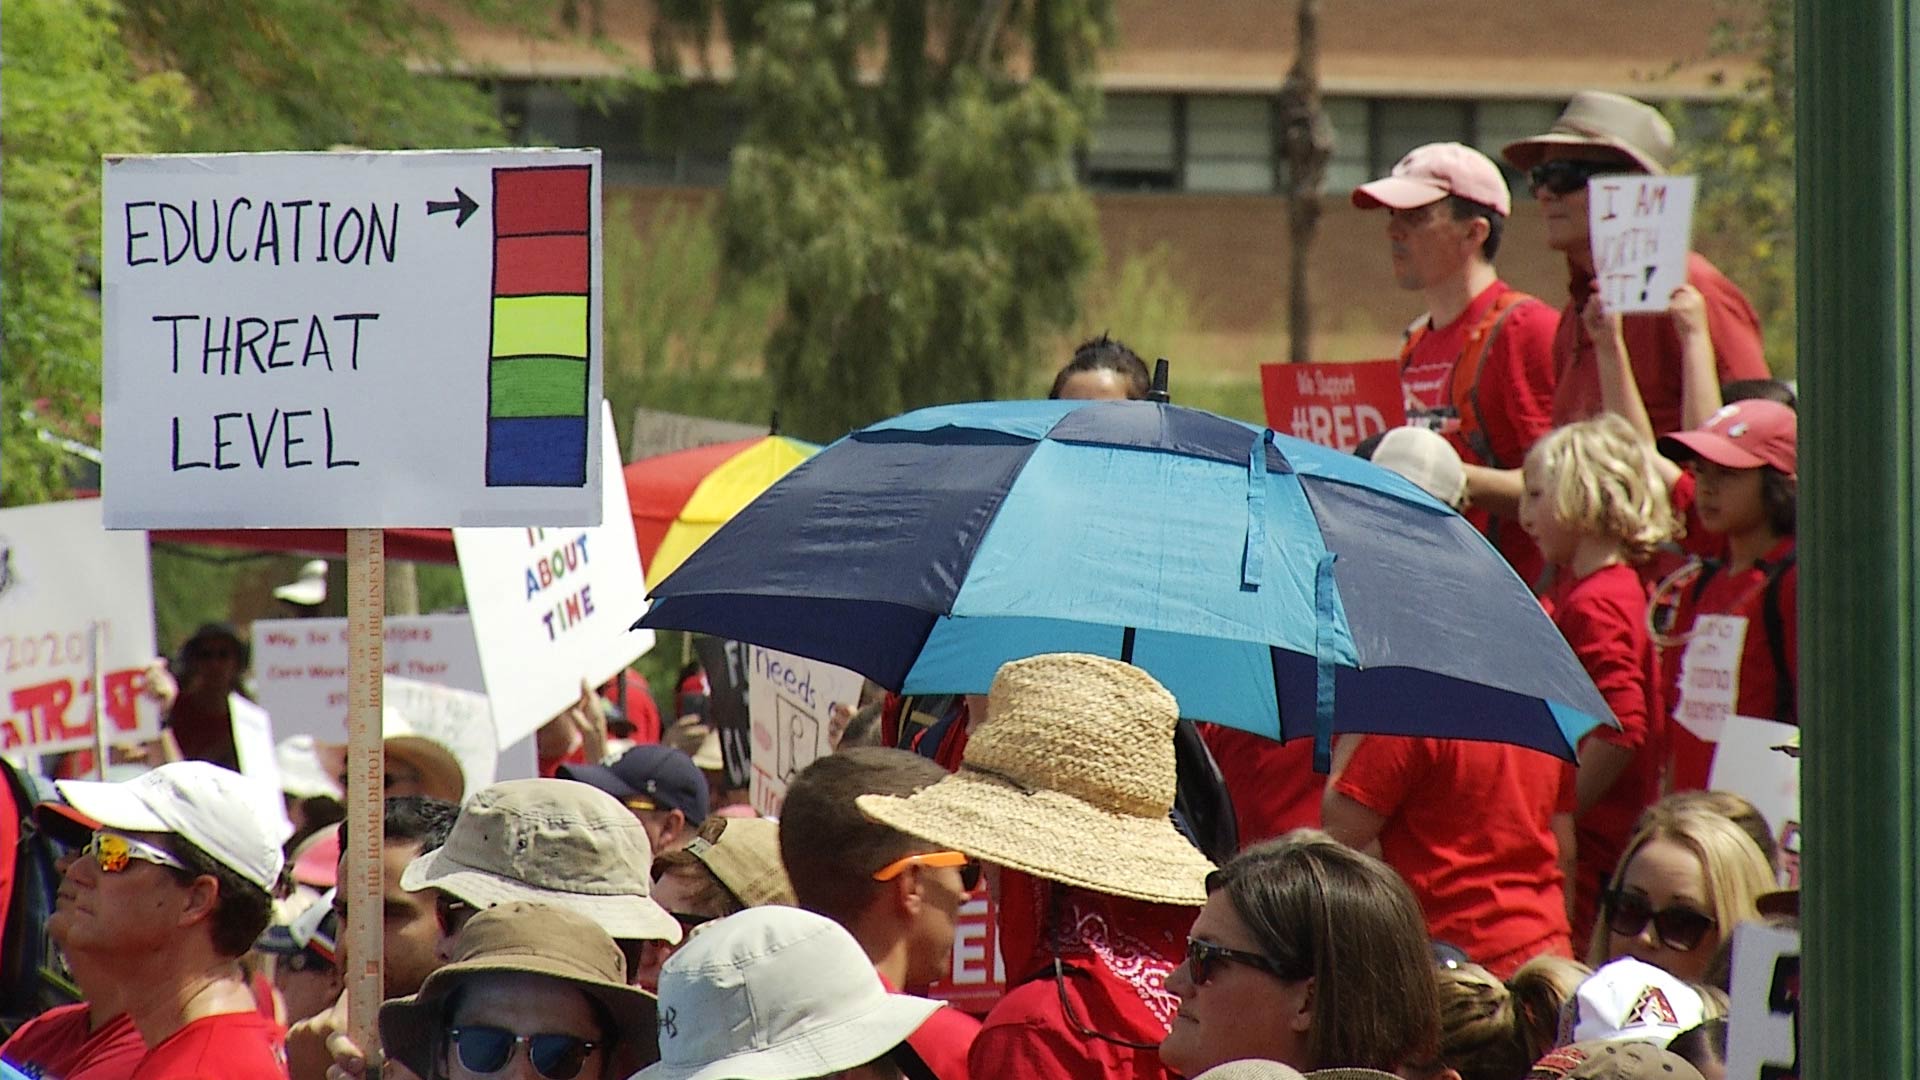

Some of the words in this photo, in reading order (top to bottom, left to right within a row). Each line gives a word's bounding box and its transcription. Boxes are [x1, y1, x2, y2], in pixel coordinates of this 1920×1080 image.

[1603, 185, 1620, 220] I
[1634, 183, 1667, 217] AM
[125, 197, 400, 266] EDUCATION
[152, 314, 380, 375] THREAT
[1296, 372, 1314, 396] We
[1317, 369, 1356, 403] Support
[171, 407, 360, 472] LEVEL
[526, 533, 588, 601] ABOUT
[542, 583, 595, 641] TIME
[755, 648, 817, 711] needs
[368, 749, 380, 803] DEPOT
[368, 813, 380, 860] HOME
[368, 865, 380, 896] THE
